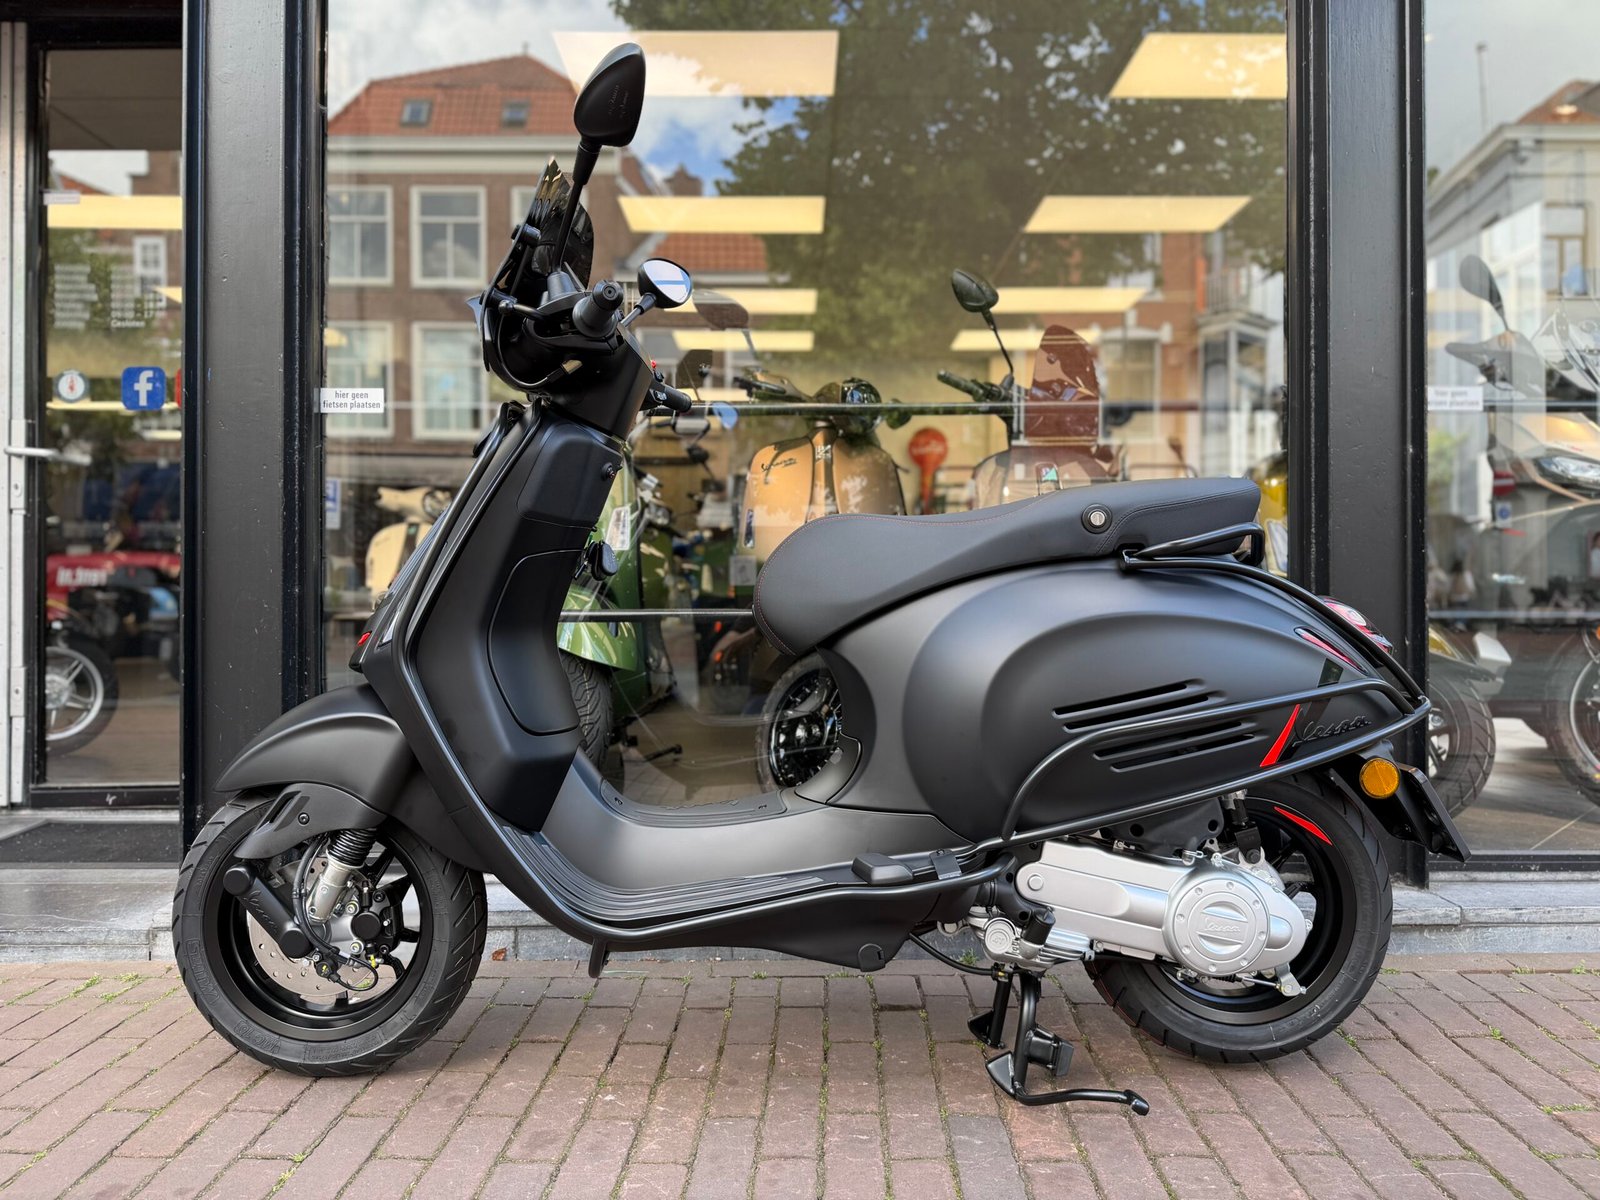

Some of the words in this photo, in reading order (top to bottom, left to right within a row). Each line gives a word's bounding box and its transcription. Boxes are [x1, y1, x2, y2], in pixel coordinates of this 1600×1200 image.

[134, 370, 153, 406] f
[335, 390, 349, 399] hier
[351, 392, 369, 400] geen
[323, 400, 348, 409] fietsen
[350, 401, 381, 410] plaatsen
[1292, 708, 1373, 747] Vespa
[1205, 917, 1241, 932] Vespa
